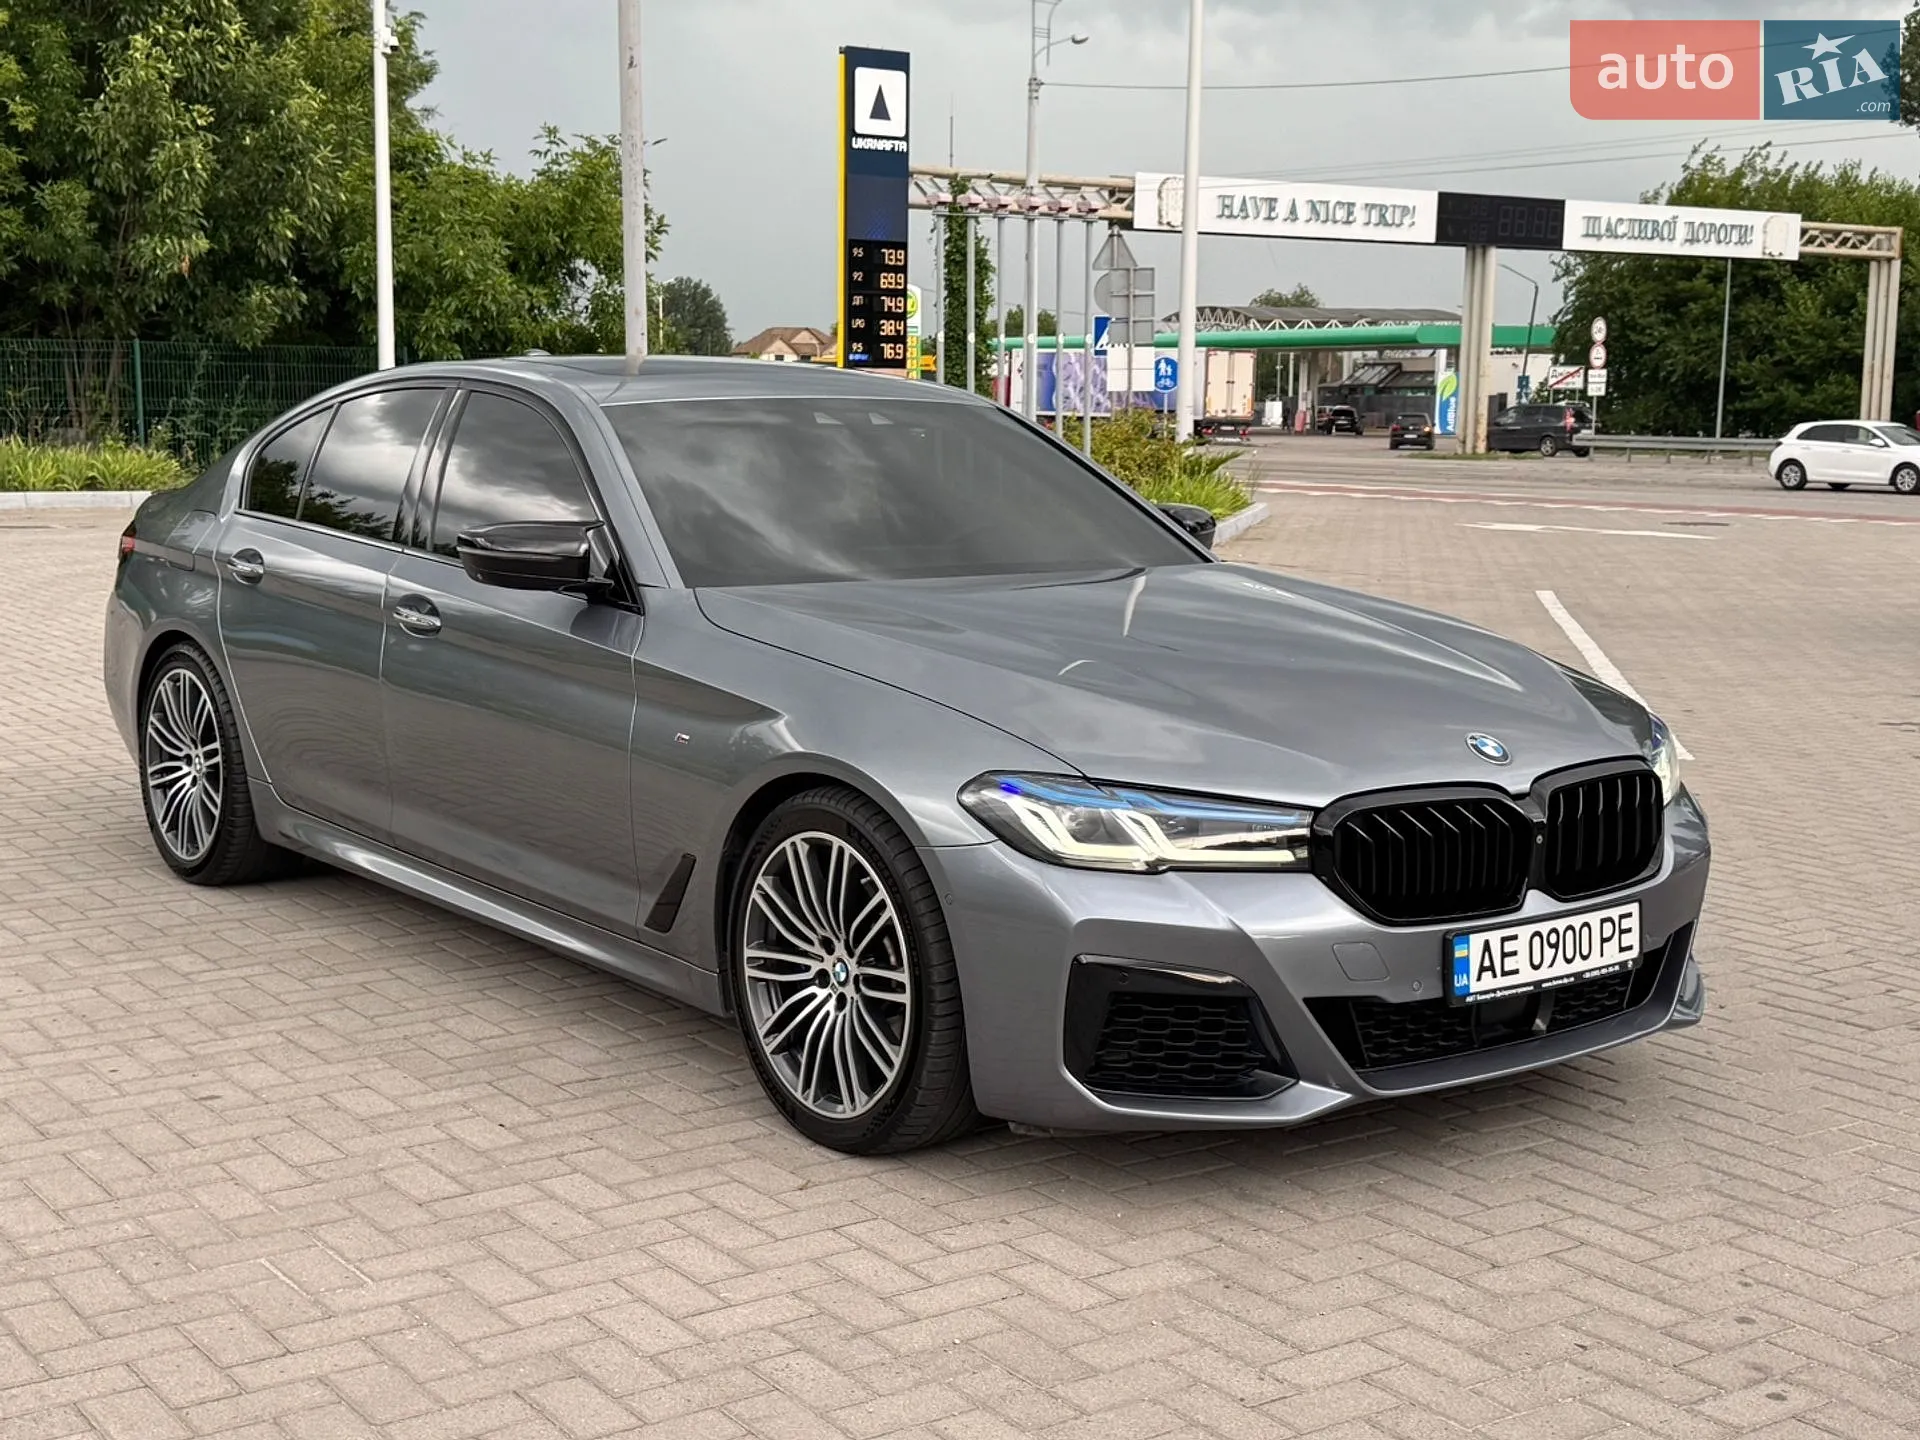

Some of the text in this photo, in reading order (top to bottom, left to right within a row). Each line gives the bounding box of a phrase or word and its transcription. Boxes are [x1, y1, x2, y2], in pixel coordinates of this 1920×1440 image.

[852, 136, 907, 152] UKRNAFTA
[1216, 194, 1416, 228] HAVE A NICE TRIP!
[1581, 215, 1754, 246] ЩАСЛИВОЇ ДОРОГИ!
[852, 247, 864, 257] 95
[852, 271, 864, 281] 92
[1476, 912, 1634, 982] AE 0900 PE
[1454, 974, 1469, 987] UA
